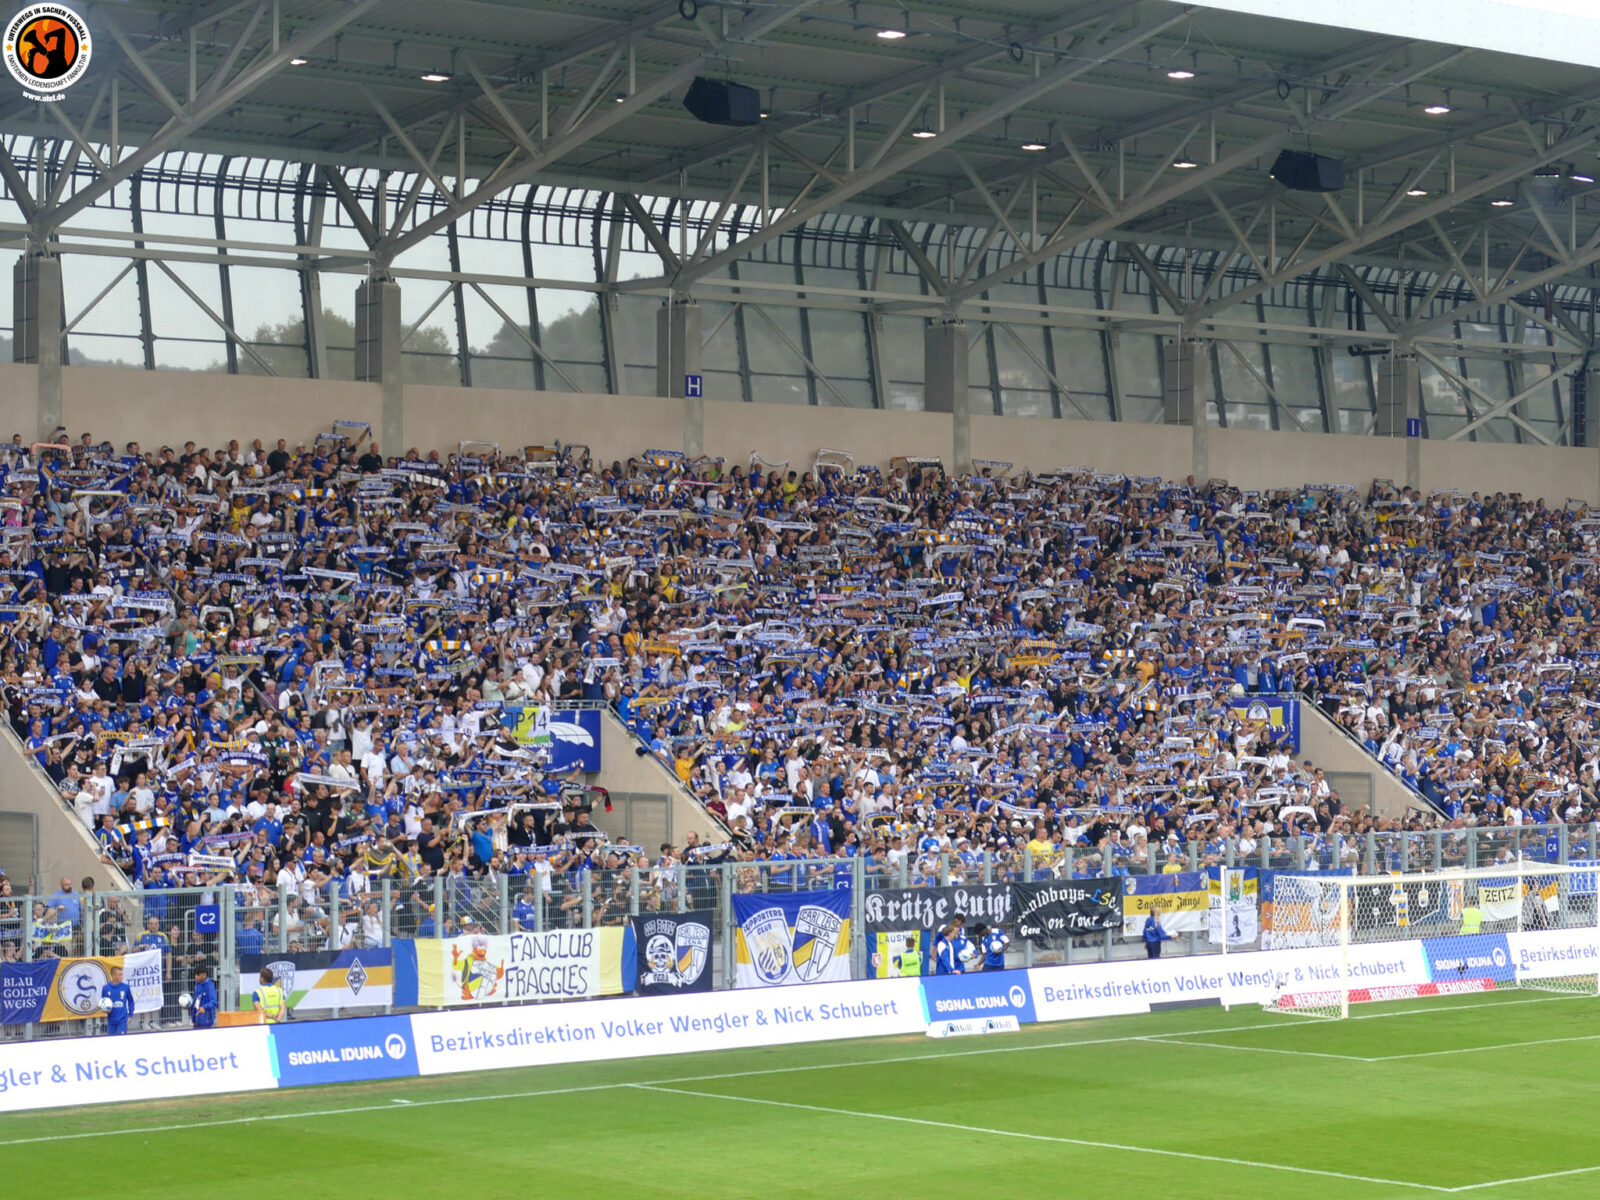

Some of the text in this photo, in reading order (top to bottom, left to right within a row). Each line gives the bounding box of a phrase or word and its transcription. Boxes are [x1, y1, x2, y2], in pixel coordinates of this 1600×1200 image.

[688, 376, 700, 396] H
[1547, 843, 1557, 852] C4
[1484, 887, 1515, 902] ZEITZ
[865, 885, 1013, 928] Krätze Luigi
[200, 913, 216, 925] C2
[1048, 912, 1100, 930] on Tour
[756, 923, 773, 936] CLUB
[804, 925, 831, 940] JENA
[510, 932, 593, 963] FANCLUB
[131, 965, 160, 977] JENAS
[3, 977, 33, 988] BLAU
[504, 964, 588, 999] FRAGGLES
[1043, 978, 1172, 1003] Bezirksdirektion
[1174, 974, 1224, 992] Volker
[1294, 967, 1304, 981] &
[1308, 964, 1341, 980] Nick
[1436, 980, 1484, 995] REMONDIS
[3, 986, 48, 999] GOLDEN
[1369, 985, 1419, 1001] REMONDIS
[4, 998, 37, 1009] WEISS
[935, 995, 1009, 1012] SIGNAL IDUNA
[431, 999, 899, 1053] Bezirksdirektion Volker Wengler & Nick Schubert
[288, 1044, 384, 1067] SIGNAL IDUNA
[50, 1064, 68, 1083] &
[75, 1055, 128, 1082] Nick
[135, 1051, 239, 1077] Schubert
